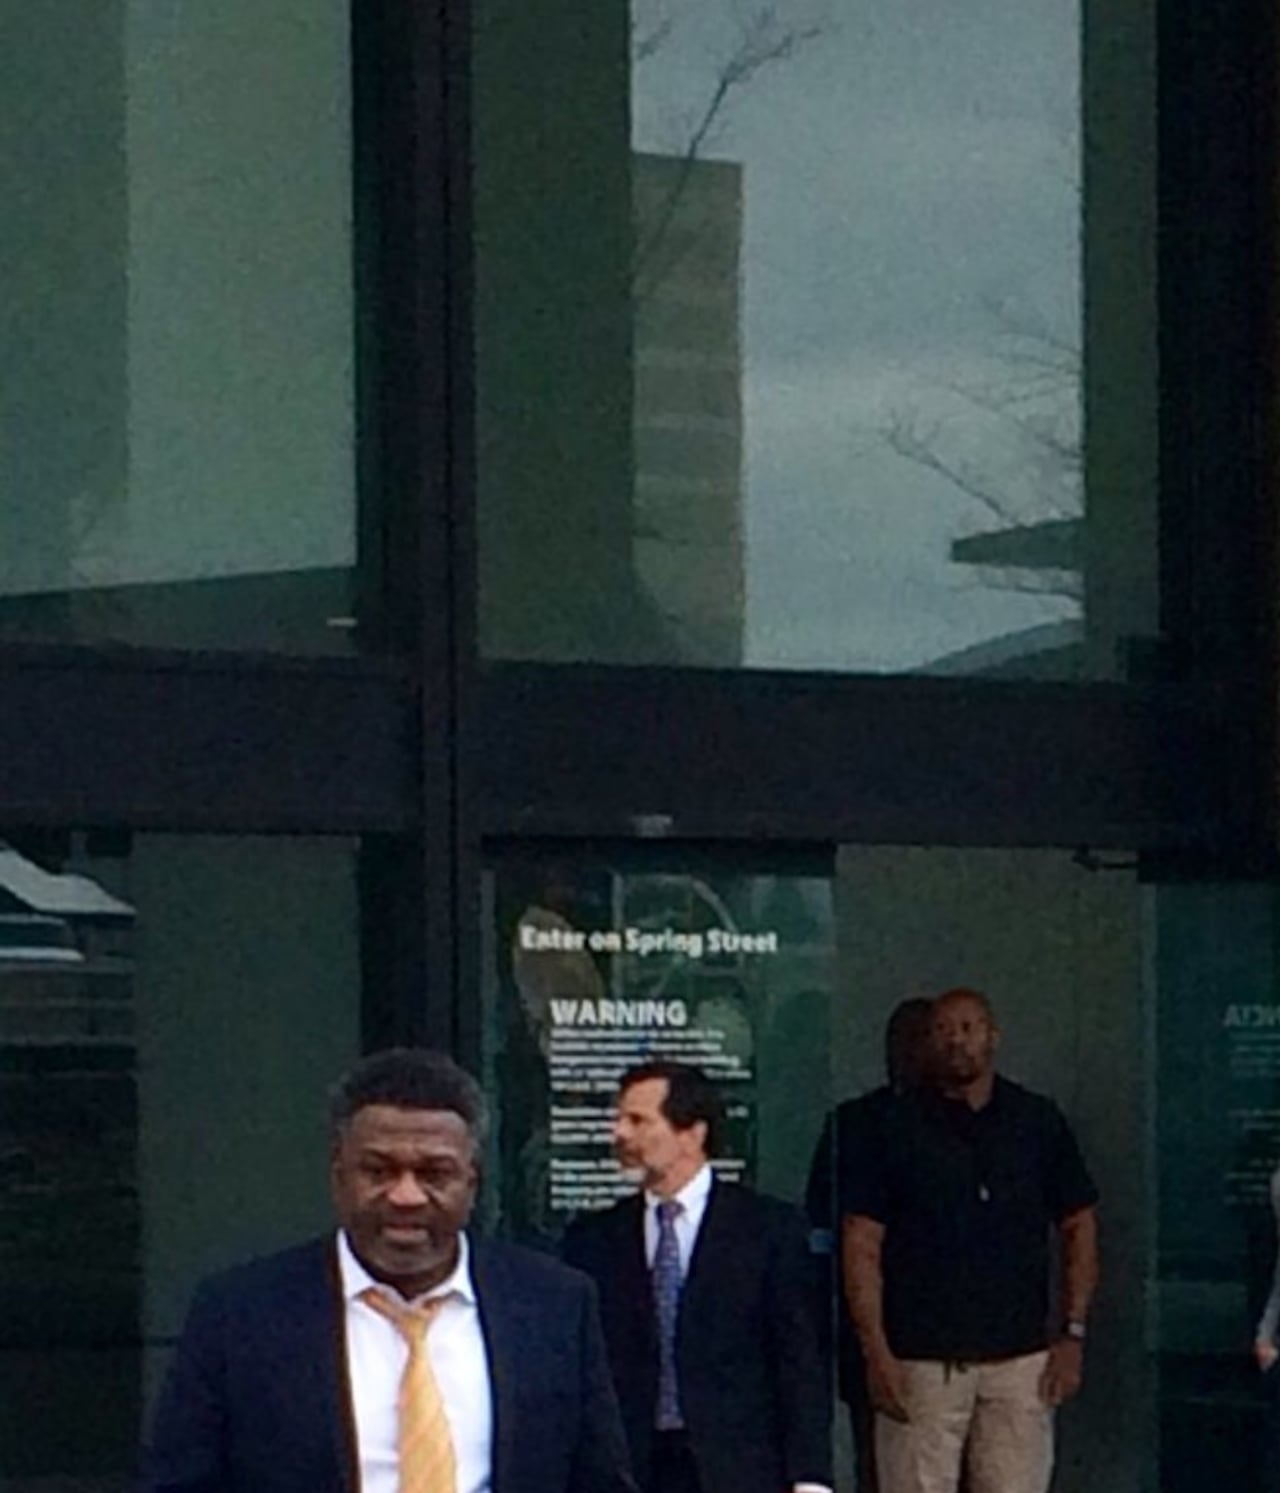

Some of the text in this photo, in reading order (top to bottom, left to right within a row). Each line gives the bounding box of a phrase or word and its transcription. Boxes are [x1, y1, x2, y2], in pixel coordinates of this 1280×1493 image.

[518, 924, 778, 957] Enter on Spring Street
[550, 999, 688, 1026] WARNING
